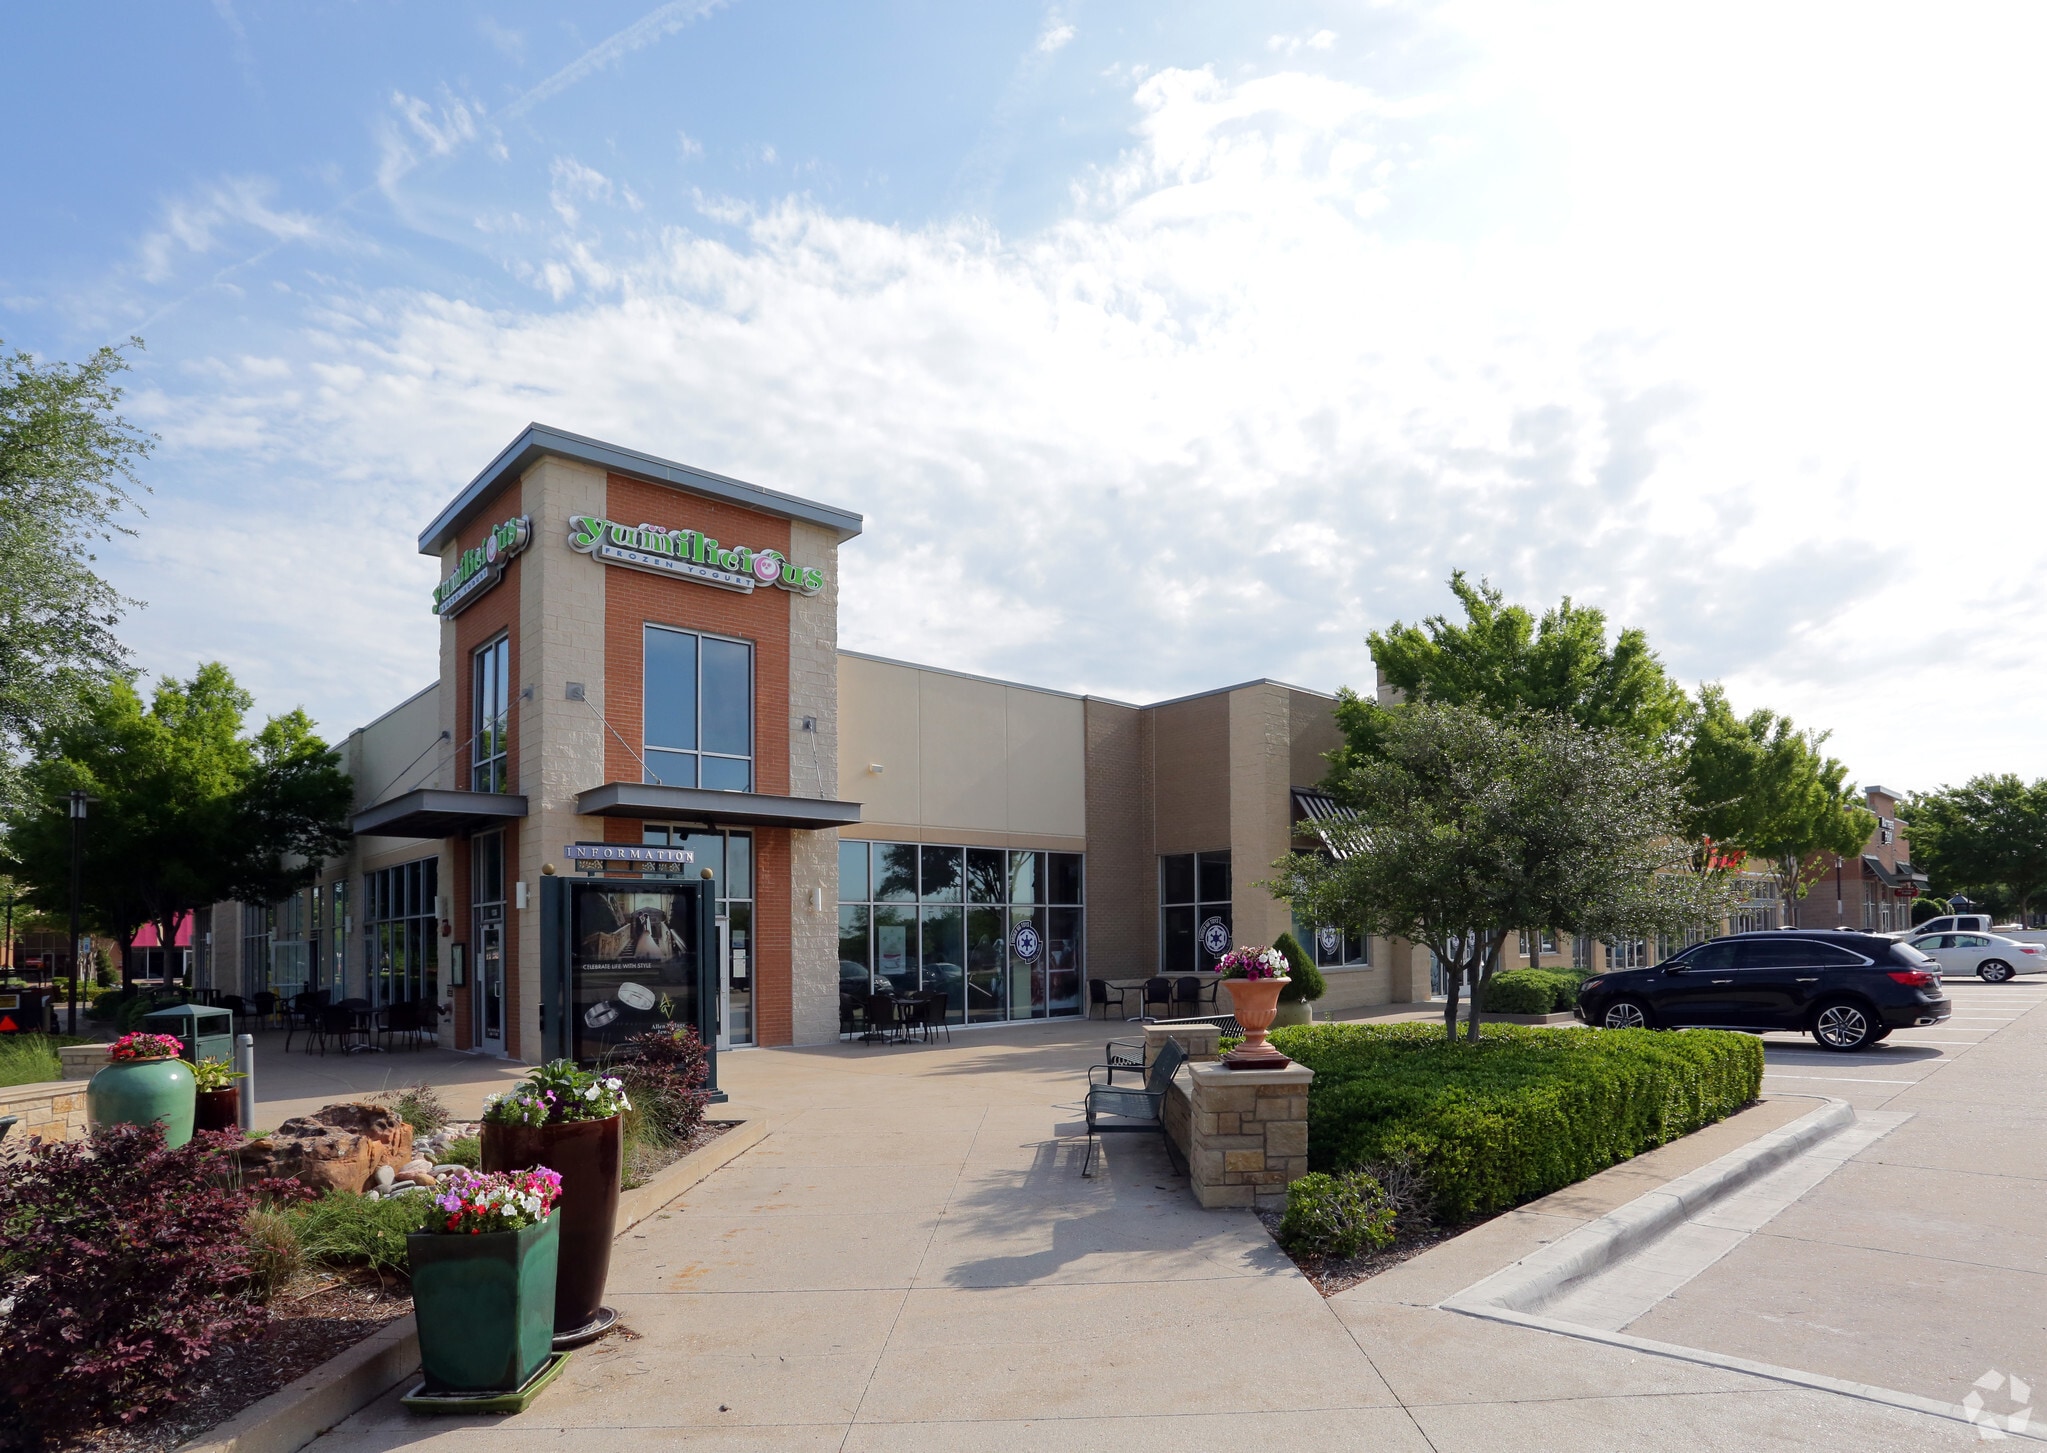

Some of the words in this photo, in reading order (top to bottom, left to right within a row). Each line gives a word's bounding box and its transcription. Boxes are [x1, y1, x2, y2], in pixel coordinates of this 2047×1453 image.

[576, 516, 823, 591] yumilicious
[605, 547, 673, 569] FROZEN
[688, 566, 751, 586] YOGURT
[566, 847, 693, 861] INFORMATION
